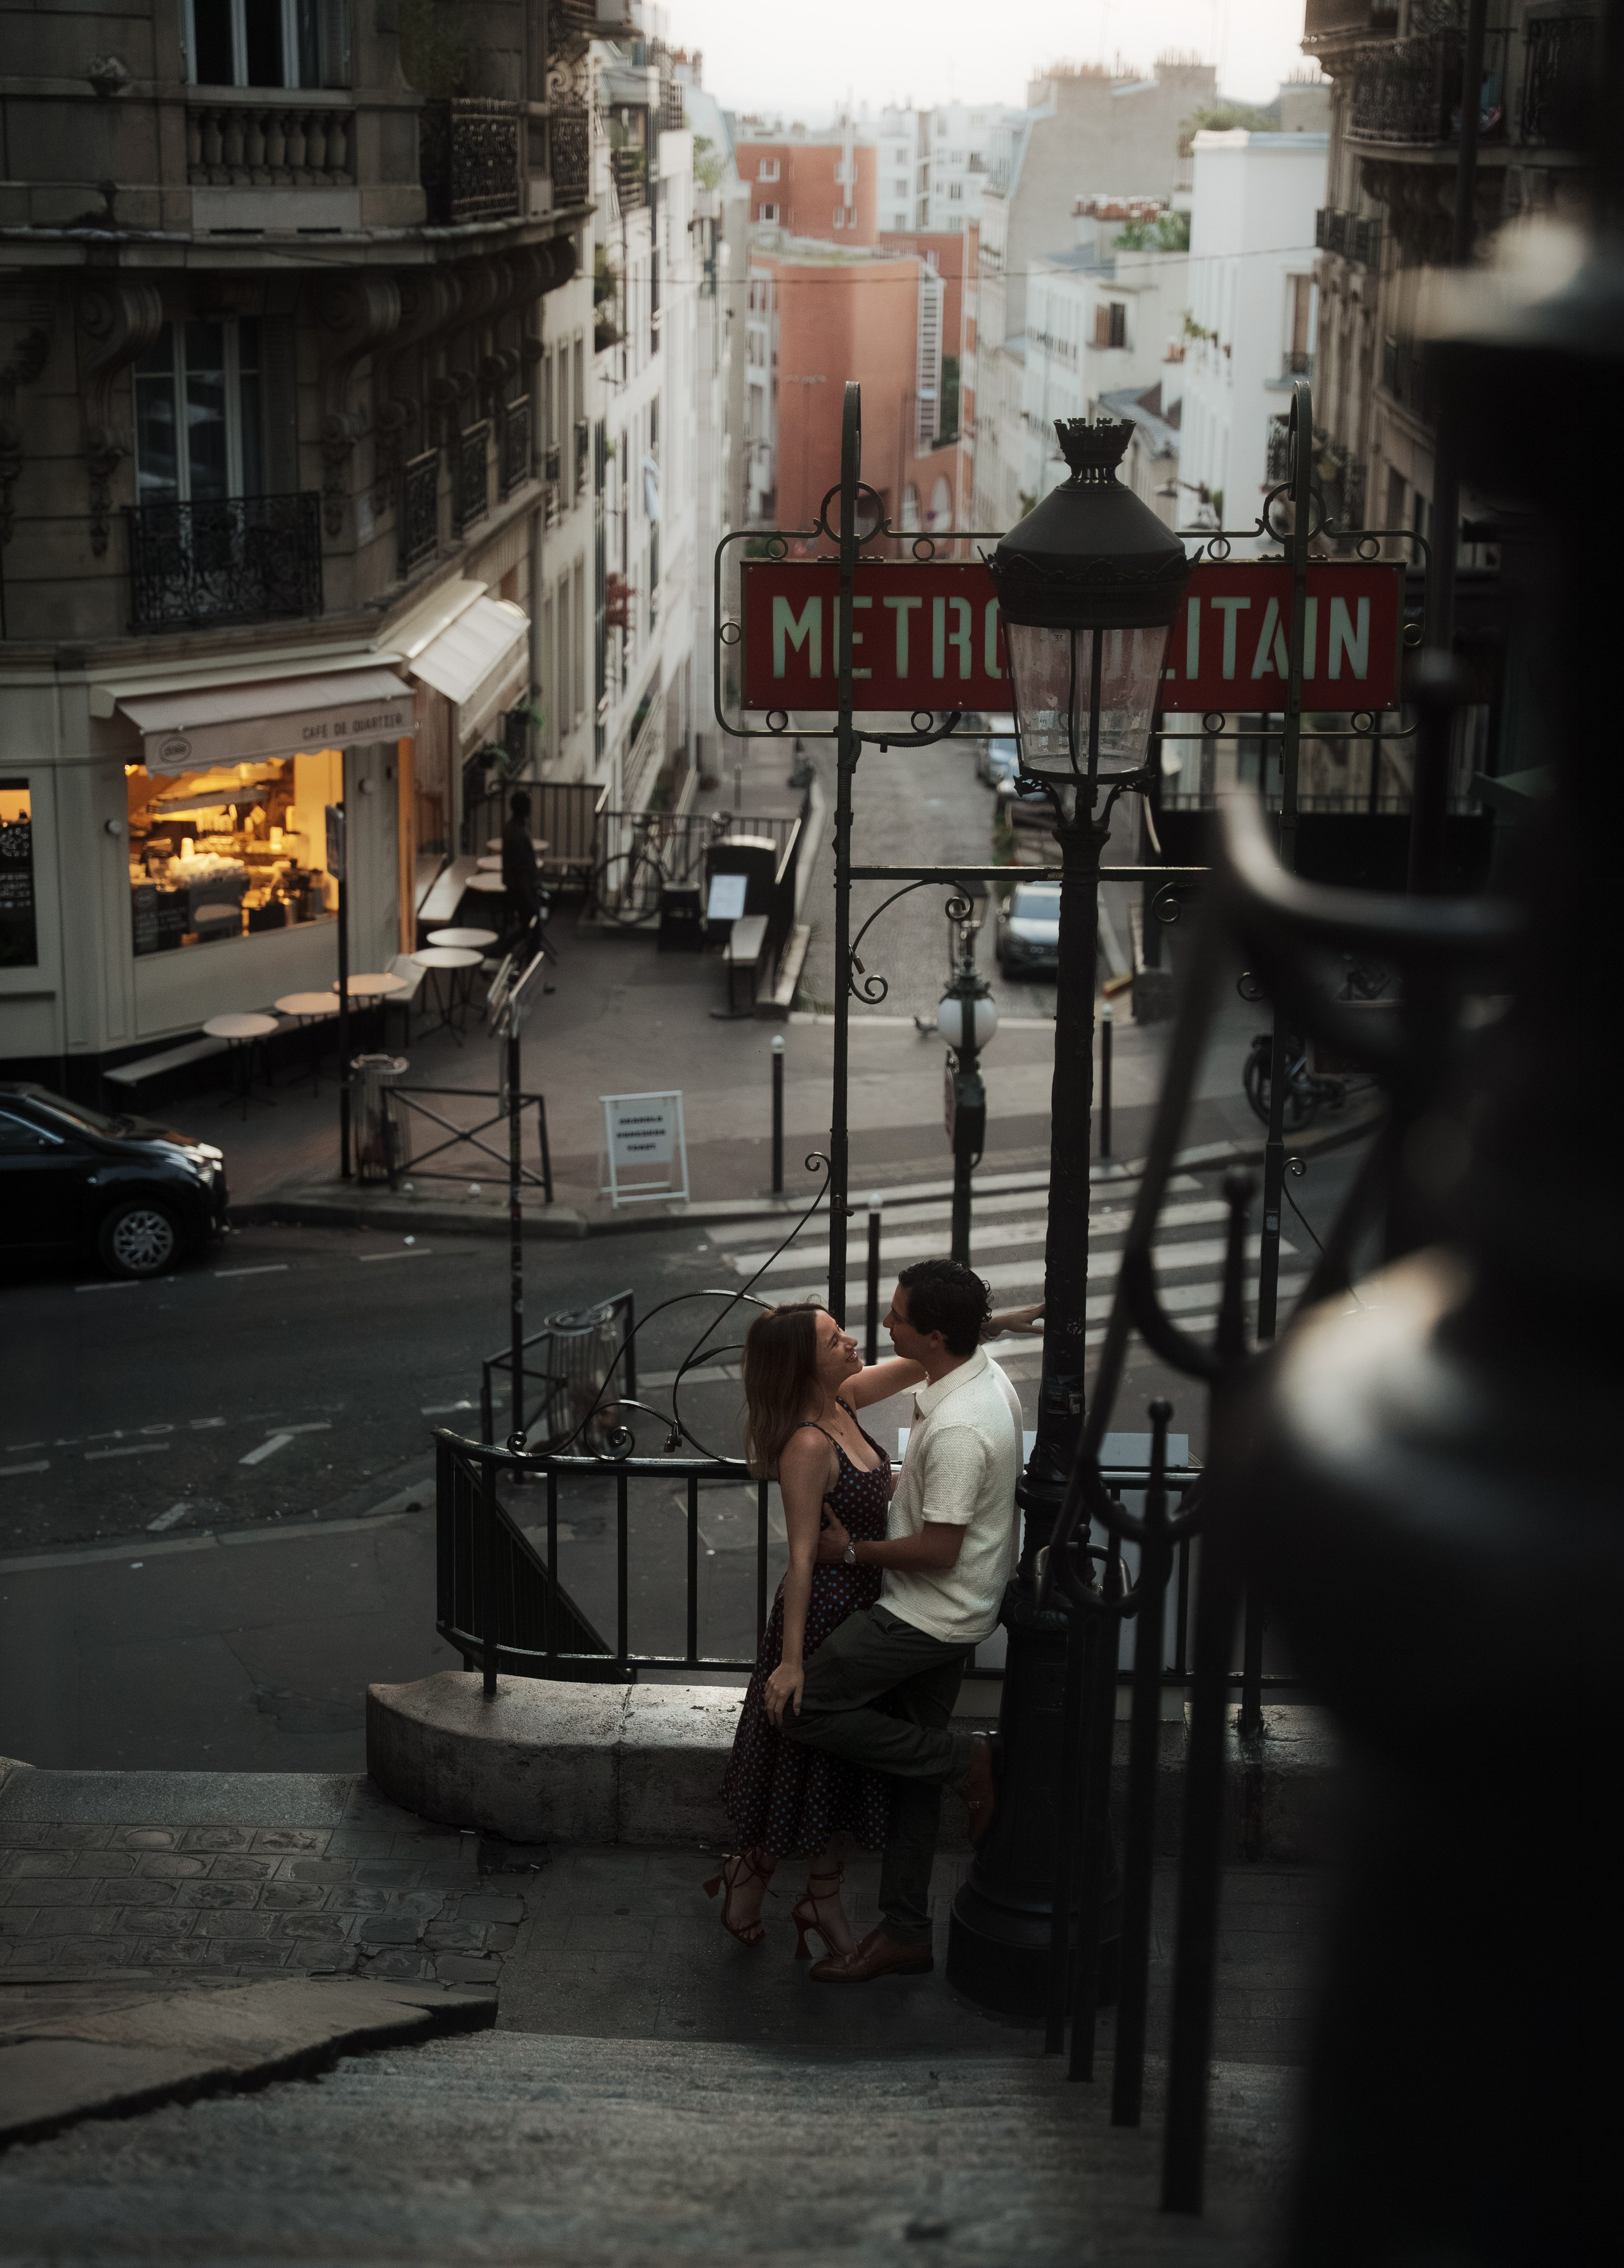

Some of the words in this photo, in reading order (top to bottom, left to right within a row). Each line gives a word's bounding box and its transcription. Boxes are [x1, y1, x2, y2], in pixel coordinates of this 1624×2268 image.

[773, 596, 1370, 679] METROITAIN
[334, 721, 347, 736] DE
[352, 712, 403, 733] QUARTIER
